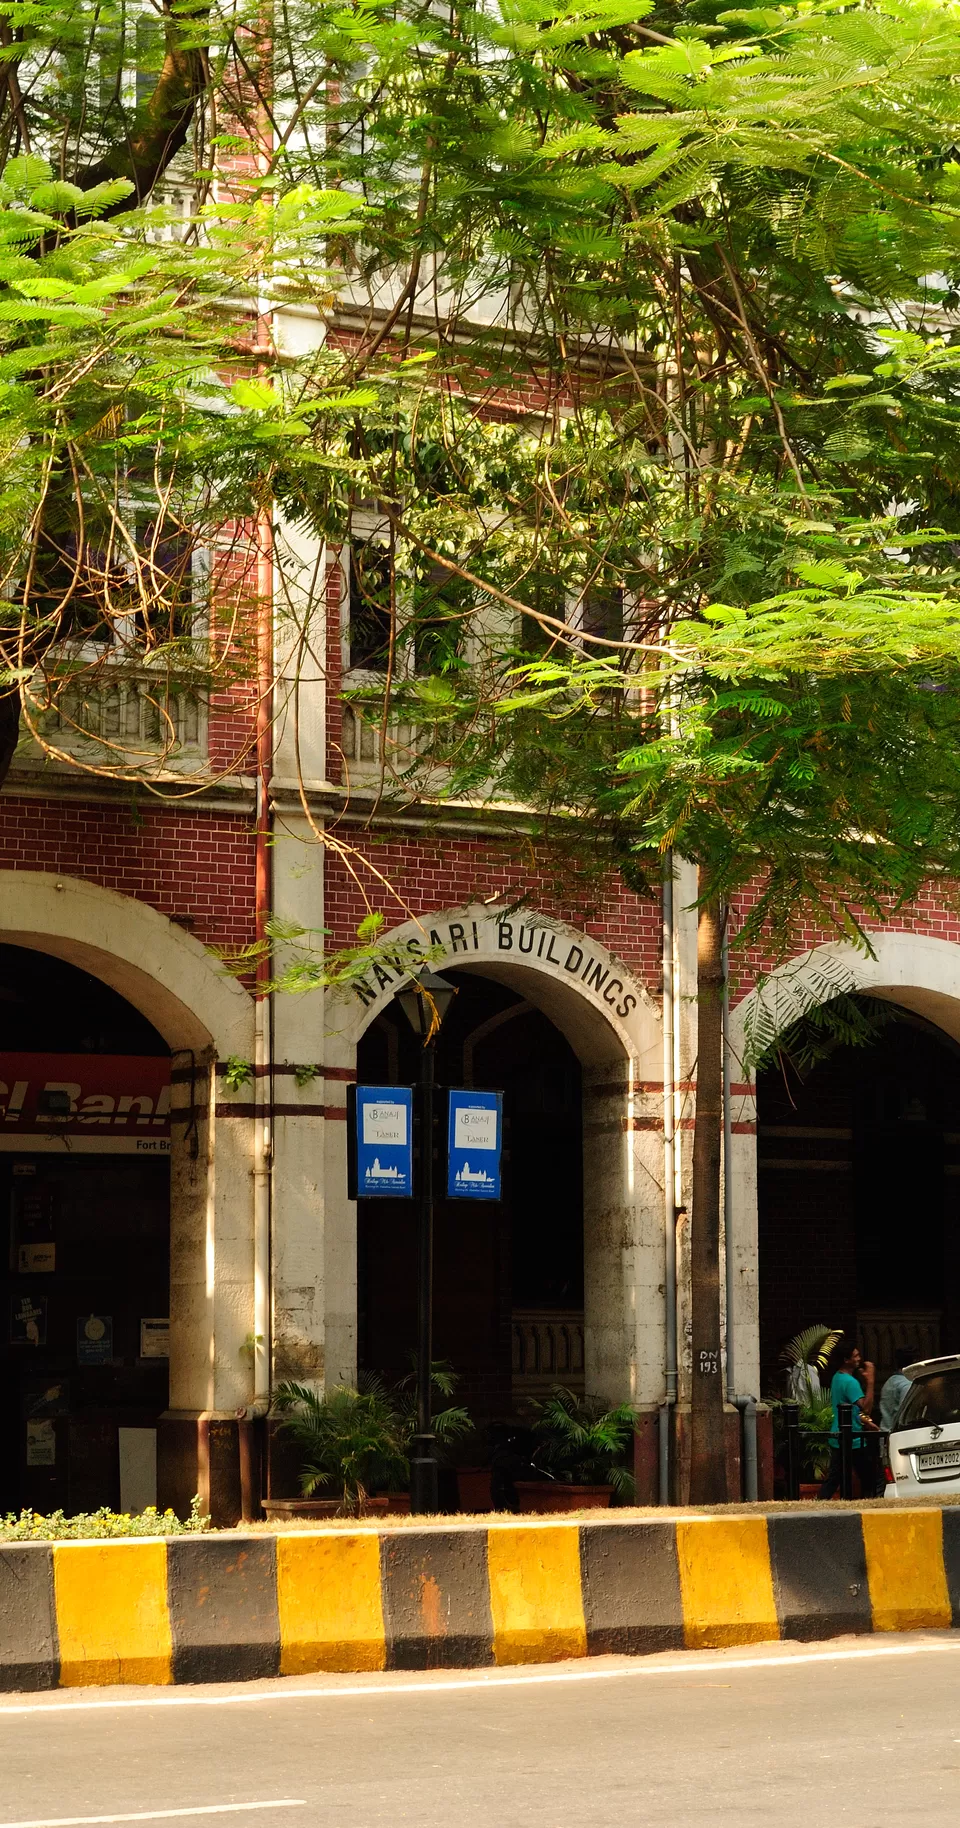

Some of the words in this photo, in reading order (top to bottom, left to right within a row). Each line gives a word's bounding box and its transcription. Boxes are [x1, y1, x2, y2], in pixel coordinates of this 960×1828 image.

[350, 921, 479, 1007] NAVSARI
[498, 922, 638, 1018] BUILDINGS
[136, 1139, 157, 1150] Fort
[699, 1350, 719, 1360] DN
[699, 1361, 718, 1374] 193
